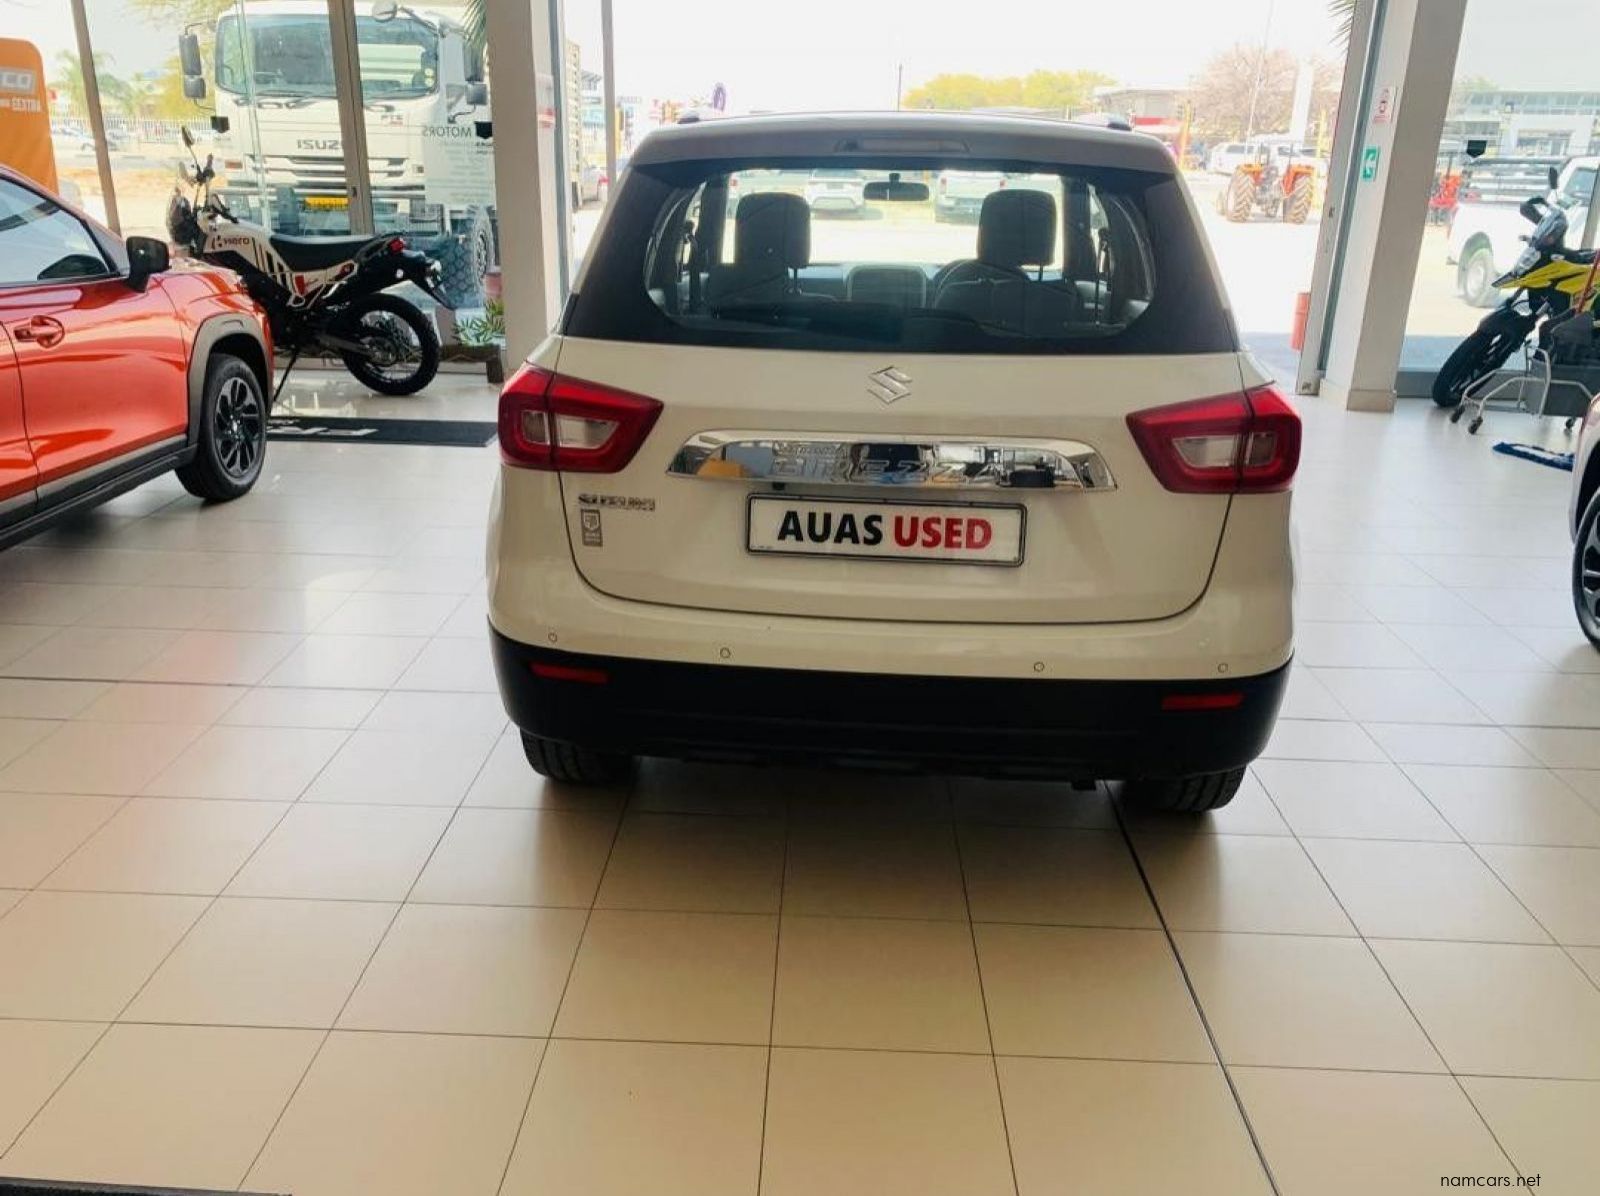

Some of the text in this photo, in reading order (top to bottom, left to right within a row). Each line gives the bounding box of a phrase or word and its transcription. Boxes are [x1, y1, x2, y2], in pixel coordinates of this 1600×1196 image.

[297, 139, 342, 150] ISUZ
[777, 510, 993, 550] AUAS USED
